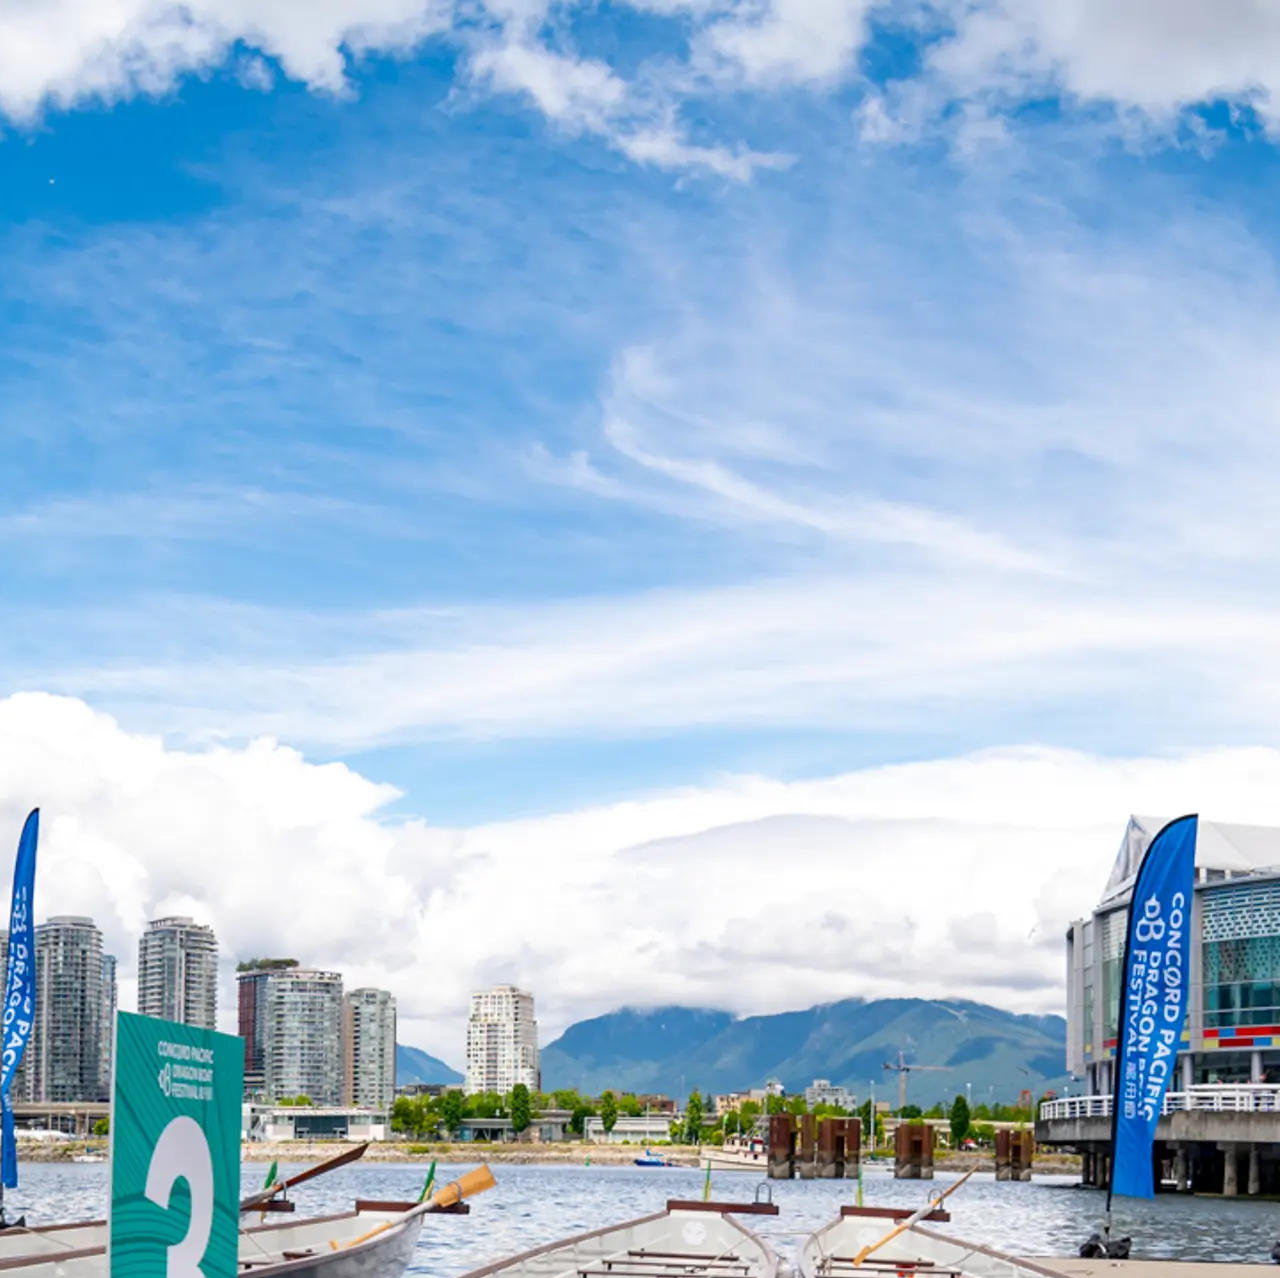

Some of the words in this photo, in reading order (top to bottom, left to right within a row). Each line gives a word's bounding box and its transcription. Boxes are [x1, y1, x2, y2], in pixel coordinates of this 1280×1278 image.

[1127, 949, 1148, 1058] FESTIVAL
[1138, 951, 1162, 1053] DRAGON
[1143, 1029, 1176, 1123] PACIFIC
